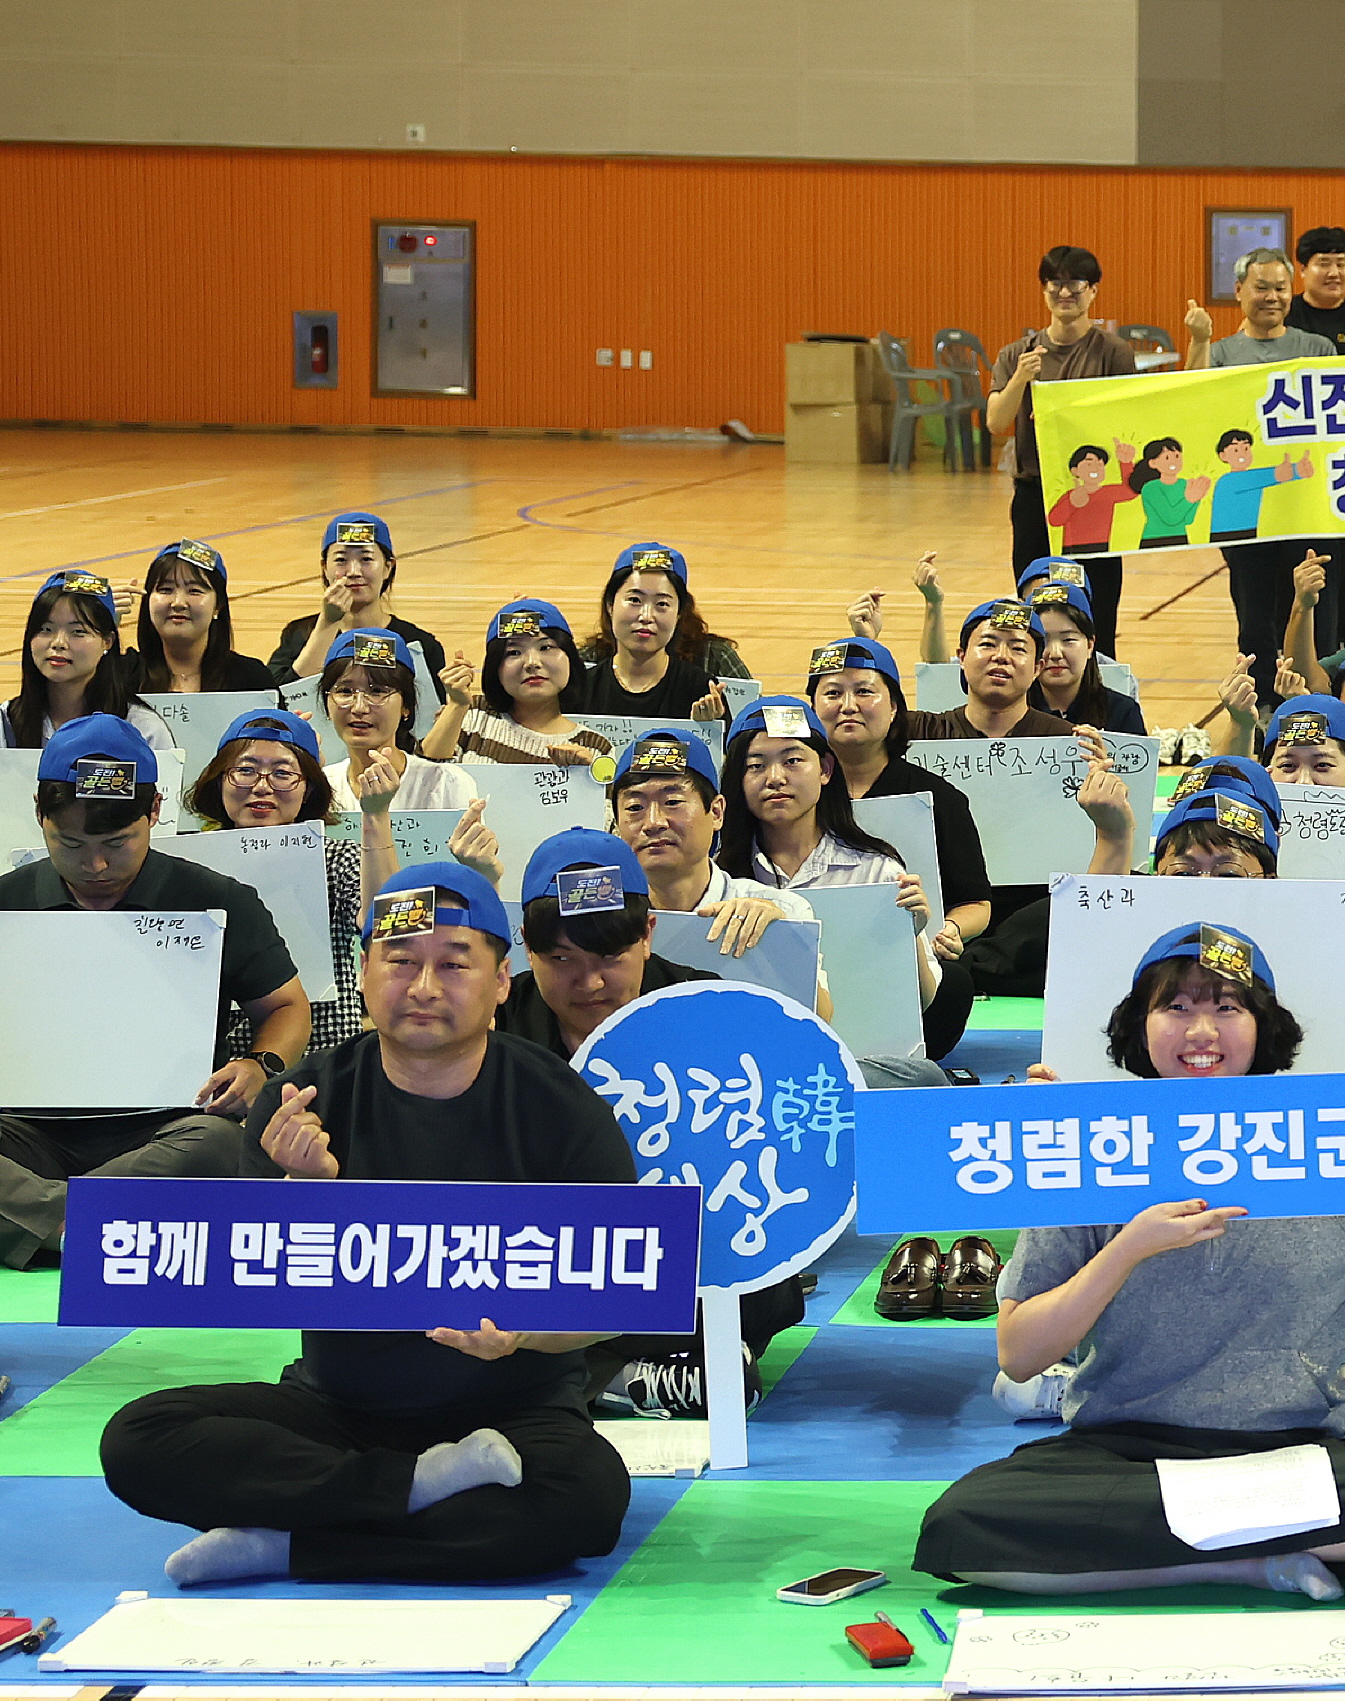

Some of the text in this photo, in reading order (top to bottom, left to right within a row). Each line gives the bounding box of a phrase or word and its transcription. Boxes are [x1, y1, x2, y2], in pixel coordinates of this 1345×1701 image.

[533, 769, 569, 787] 관광과
[539, 788, 569, 805] 김보우
[1077, 885, 1135, 911] 축산과
[949, 1115, 1154, 1194] 청렴한
[101, 1220, 664, 1291] 함께 만들어가겠습니다
